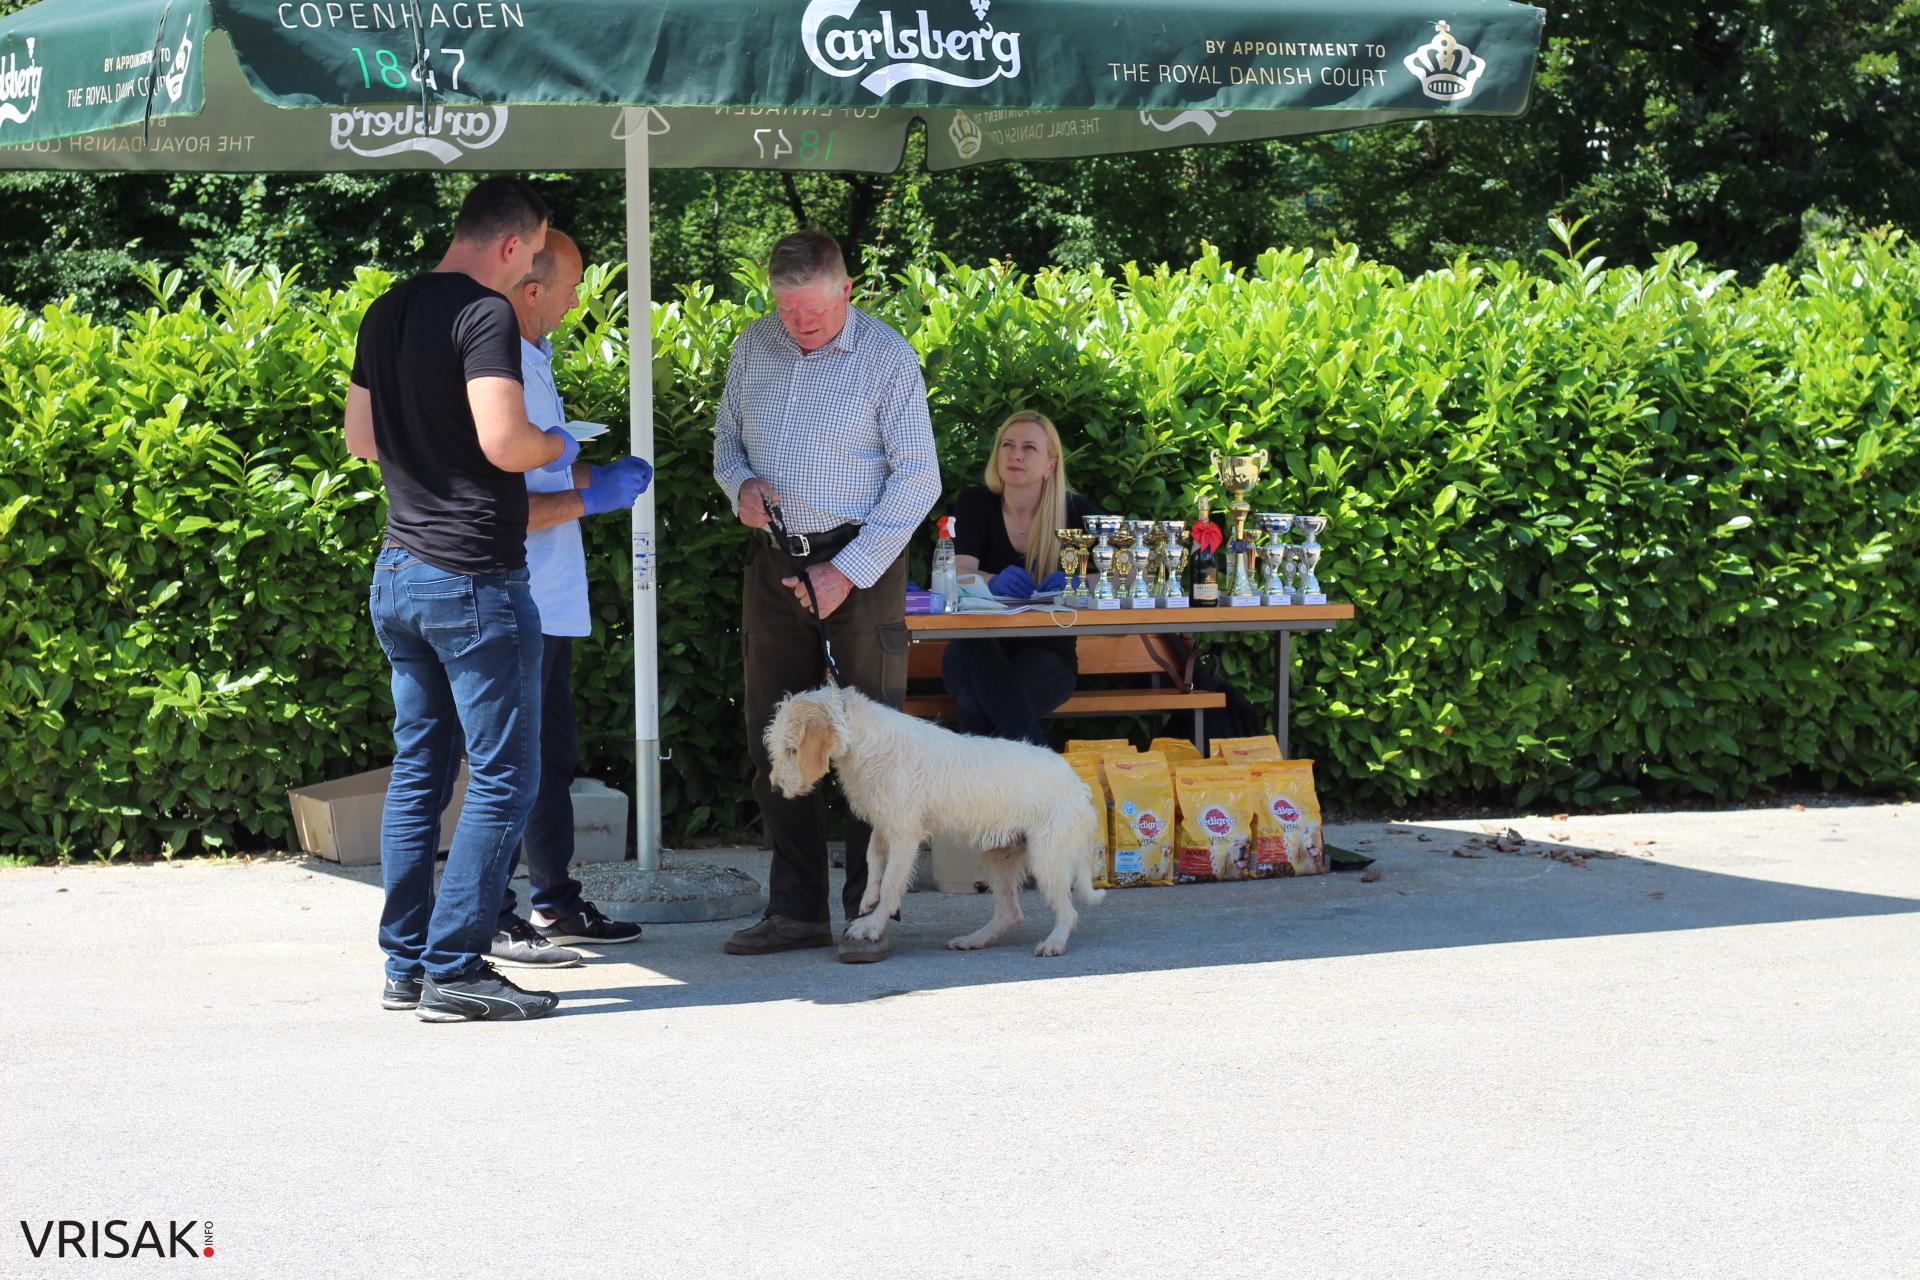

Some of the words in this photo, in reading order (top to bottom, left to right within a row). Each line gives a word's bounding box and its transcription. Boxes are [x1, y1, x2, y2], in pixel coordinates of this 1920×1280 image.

[278, 2, 525, 30] COPENHAGEN
[104, 57, 114, 73] BY
[160, 47, 171, 62] TO
[801, 0, 1021, 97] Carlsberg
[1206, 40, 1225, 55] BY
[1233, 41, 1359, 58] APPOINTMENT
[1365, 44, 1386, 59] TO
[0, 53, 43, 112] lsberg
[352, 47, 466, 91] 1847
[1109, 62, 1150, 83] THE
[1159, 64, 1222, 85] ROYAL
[1230, 65, 1312, 86] DANISH
[1320, 66, 1388, 88] COURT
[67, 89, 83, 108] THE
[86, 85, 113, 107] ROYAL
